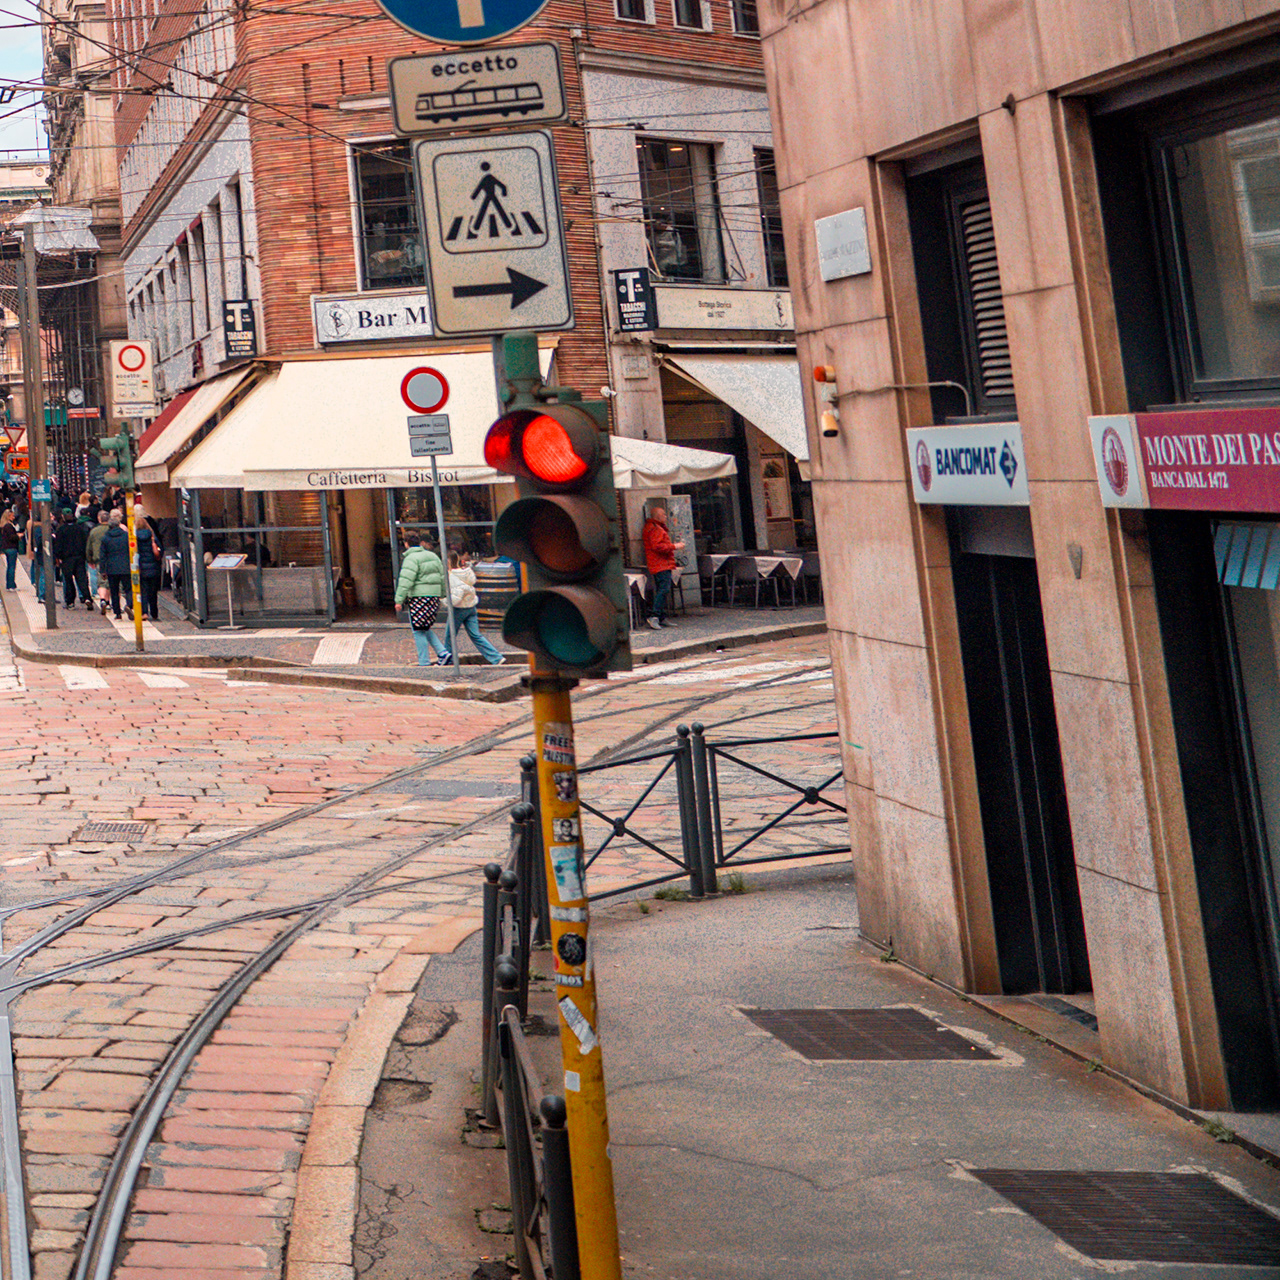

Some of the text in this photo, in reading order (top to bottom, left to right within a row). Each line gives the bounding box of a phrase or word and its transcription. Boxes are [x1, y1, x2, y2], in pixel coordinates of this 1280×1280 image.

[431, 56, 518, 77] eccetto
[357, 310, 397, 328] Bar
[1144, 434, 1212, 466] MONTE
[1211, 433, 1248, 465] DEI
[935, 447, 997, 475] BANCOMAT
[307, 470, 460, 487] Caffetteria Bisrot
[1150, 471, 1229, 488] BANCA DAL 1472
